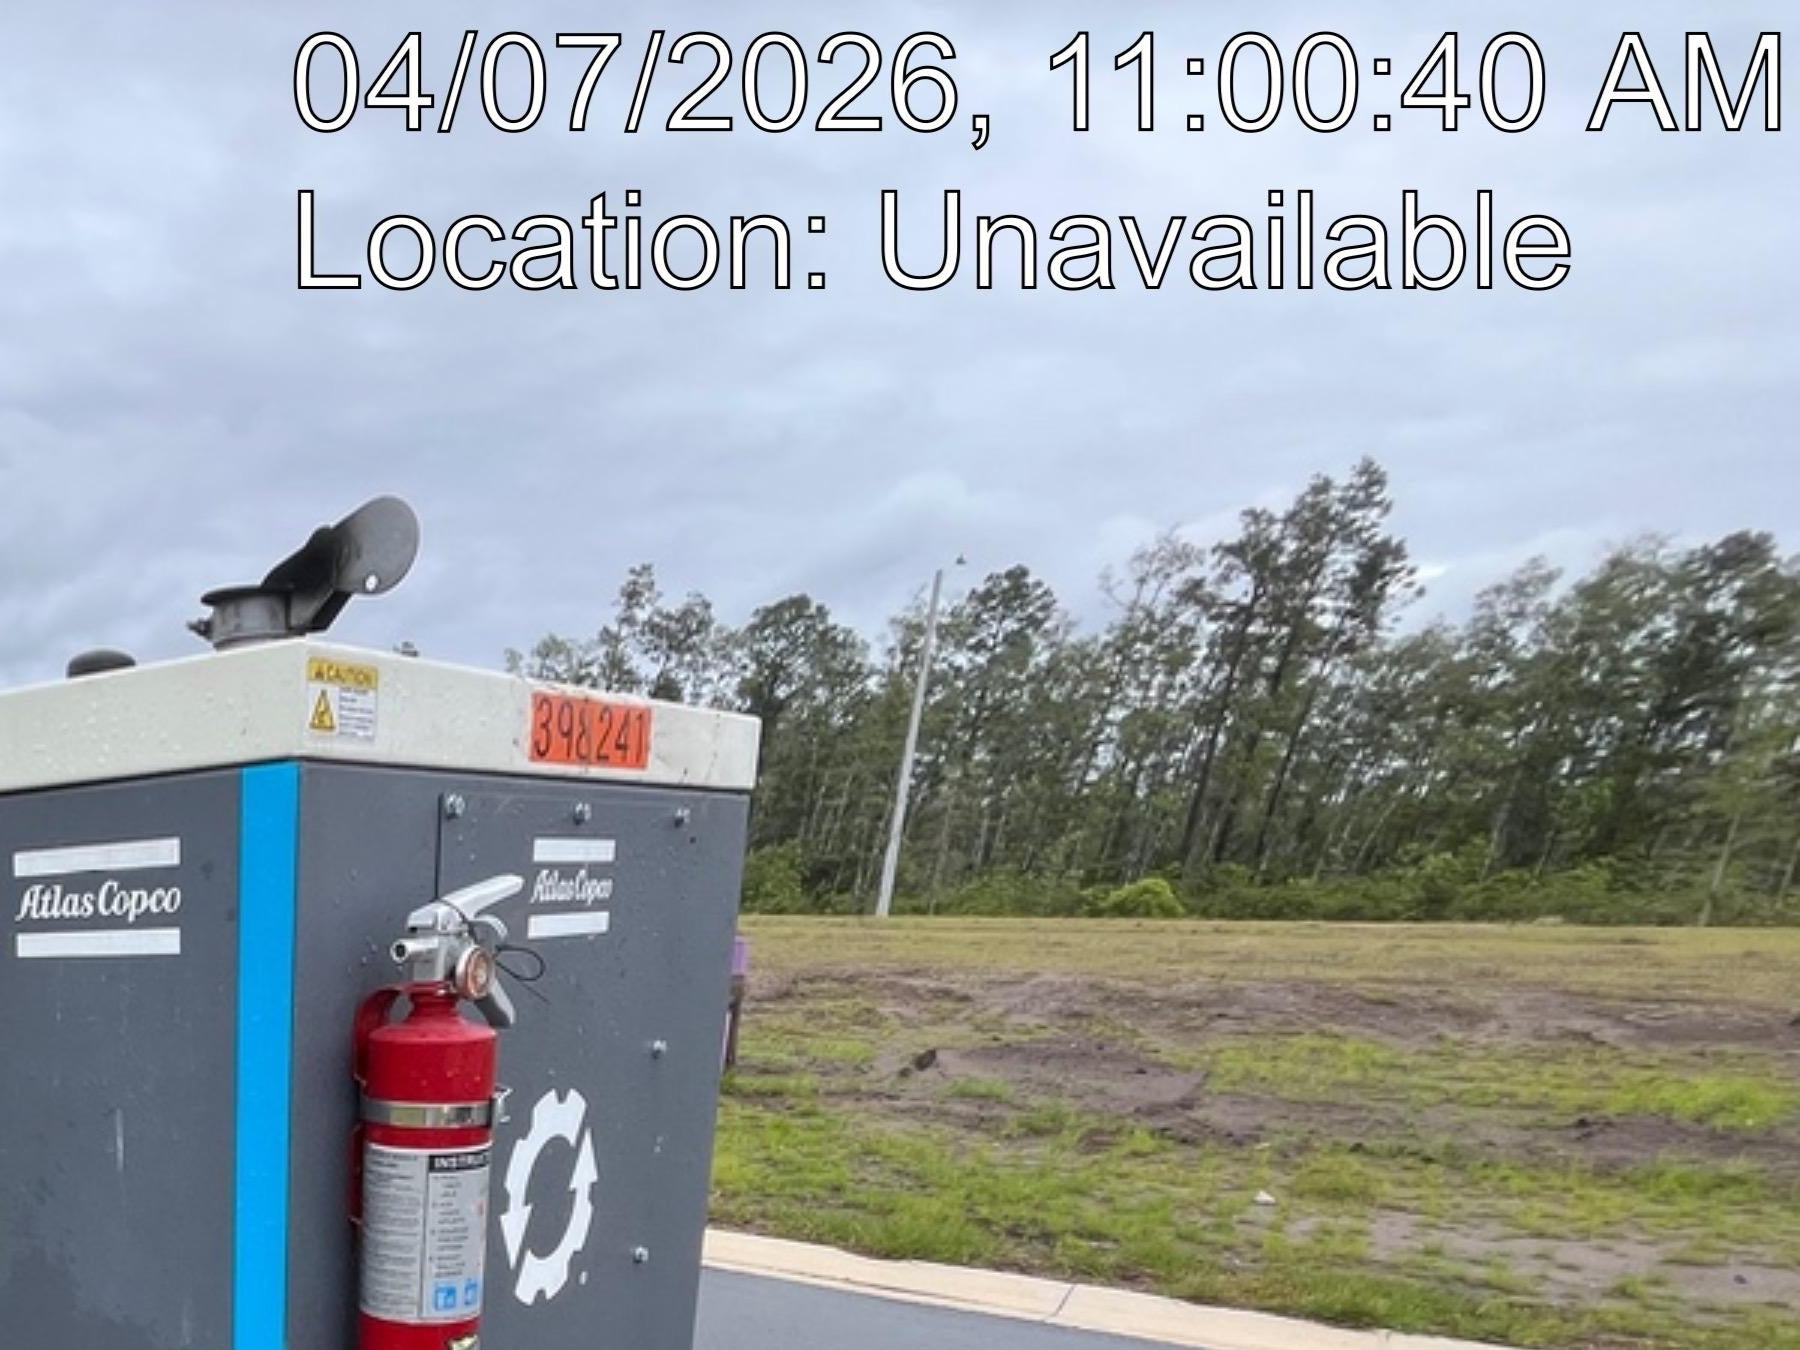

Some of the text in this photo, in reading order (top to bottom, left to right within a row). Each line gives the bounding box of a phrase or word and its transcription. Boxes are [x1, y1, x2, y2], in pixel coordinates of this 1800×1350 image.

[535, 698, 646, 762] 398241
[15, 879, 182, 923] Atlas Copco
